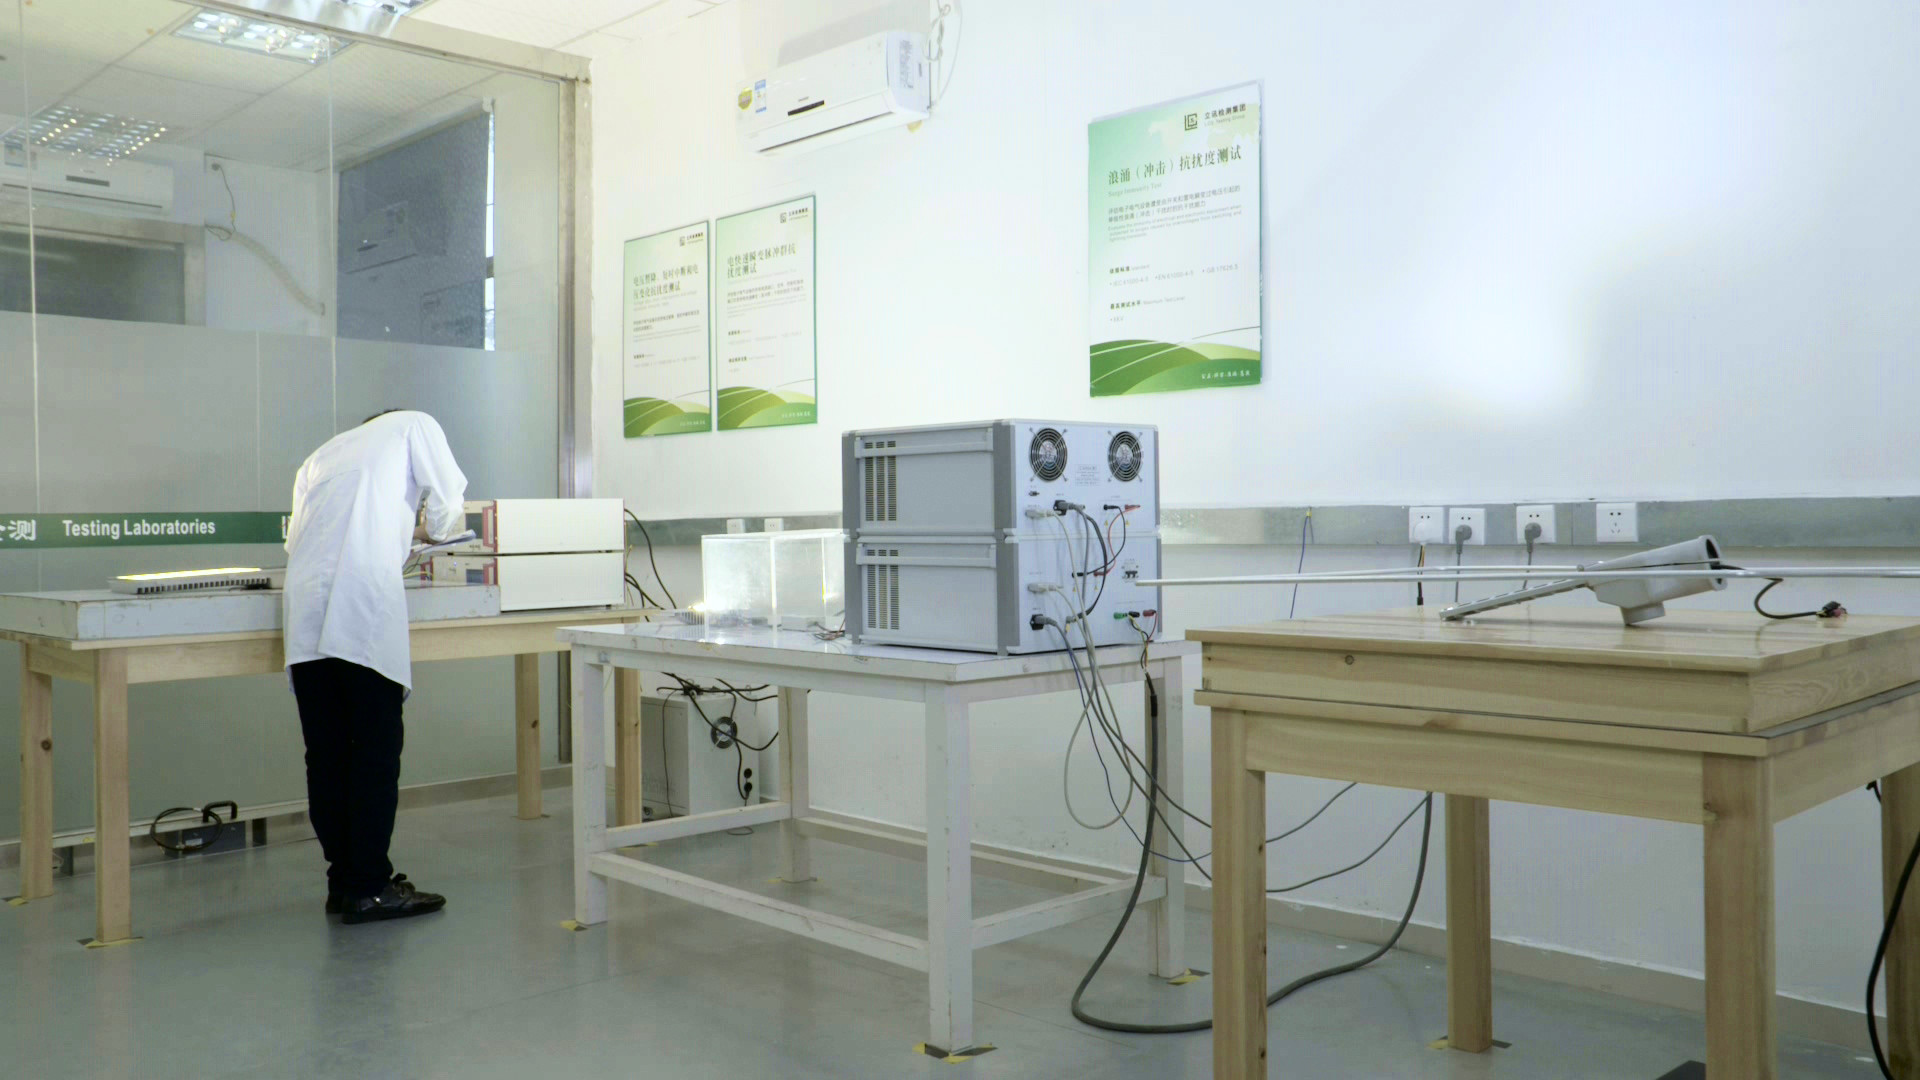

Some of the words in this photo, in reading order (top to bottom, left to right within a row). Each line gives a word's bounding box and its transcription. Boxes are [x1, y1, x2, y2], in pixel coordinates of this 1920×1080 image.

[1108, 145, 1242, 185] 浪涌（冲击）抗扰度测试
[0, 519, 37, 541] 测
[62, 519, 120, 540] Testing
[124, 519, 216, 537] Laboratories
